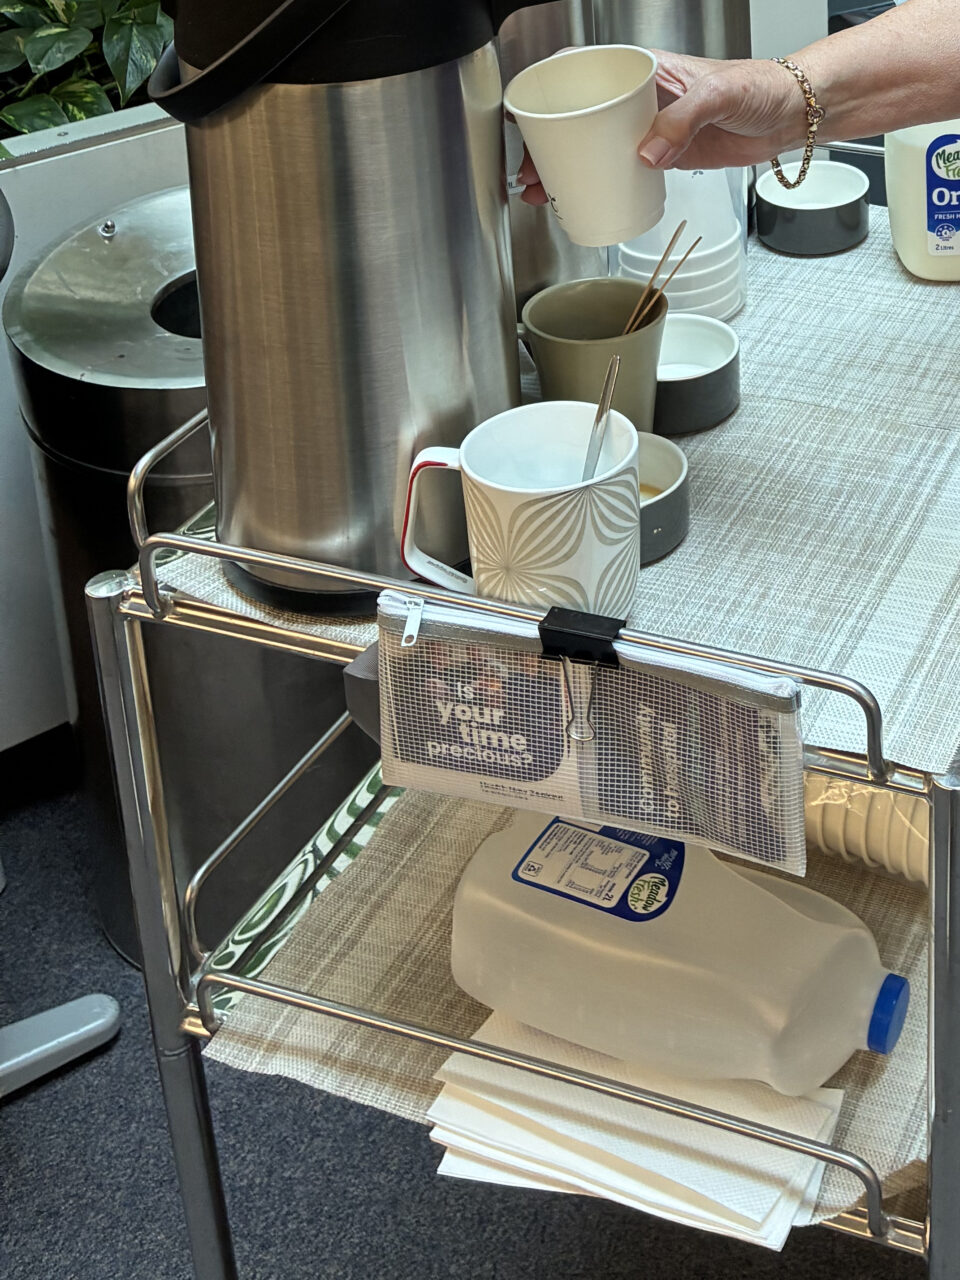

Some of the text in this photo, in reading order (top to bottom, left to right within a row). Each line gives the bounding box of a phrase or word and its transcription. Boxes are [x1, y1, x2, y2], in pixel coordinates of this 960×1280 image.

[456, 682, 474, 700] Is
[435, 700, 505, 725] your
[459, 722, 527, 751] time
[426, 740, 534, 768] precious?
[630, 879, 652, 907] Fresh
[641, 876, 667, 912] Meadow
